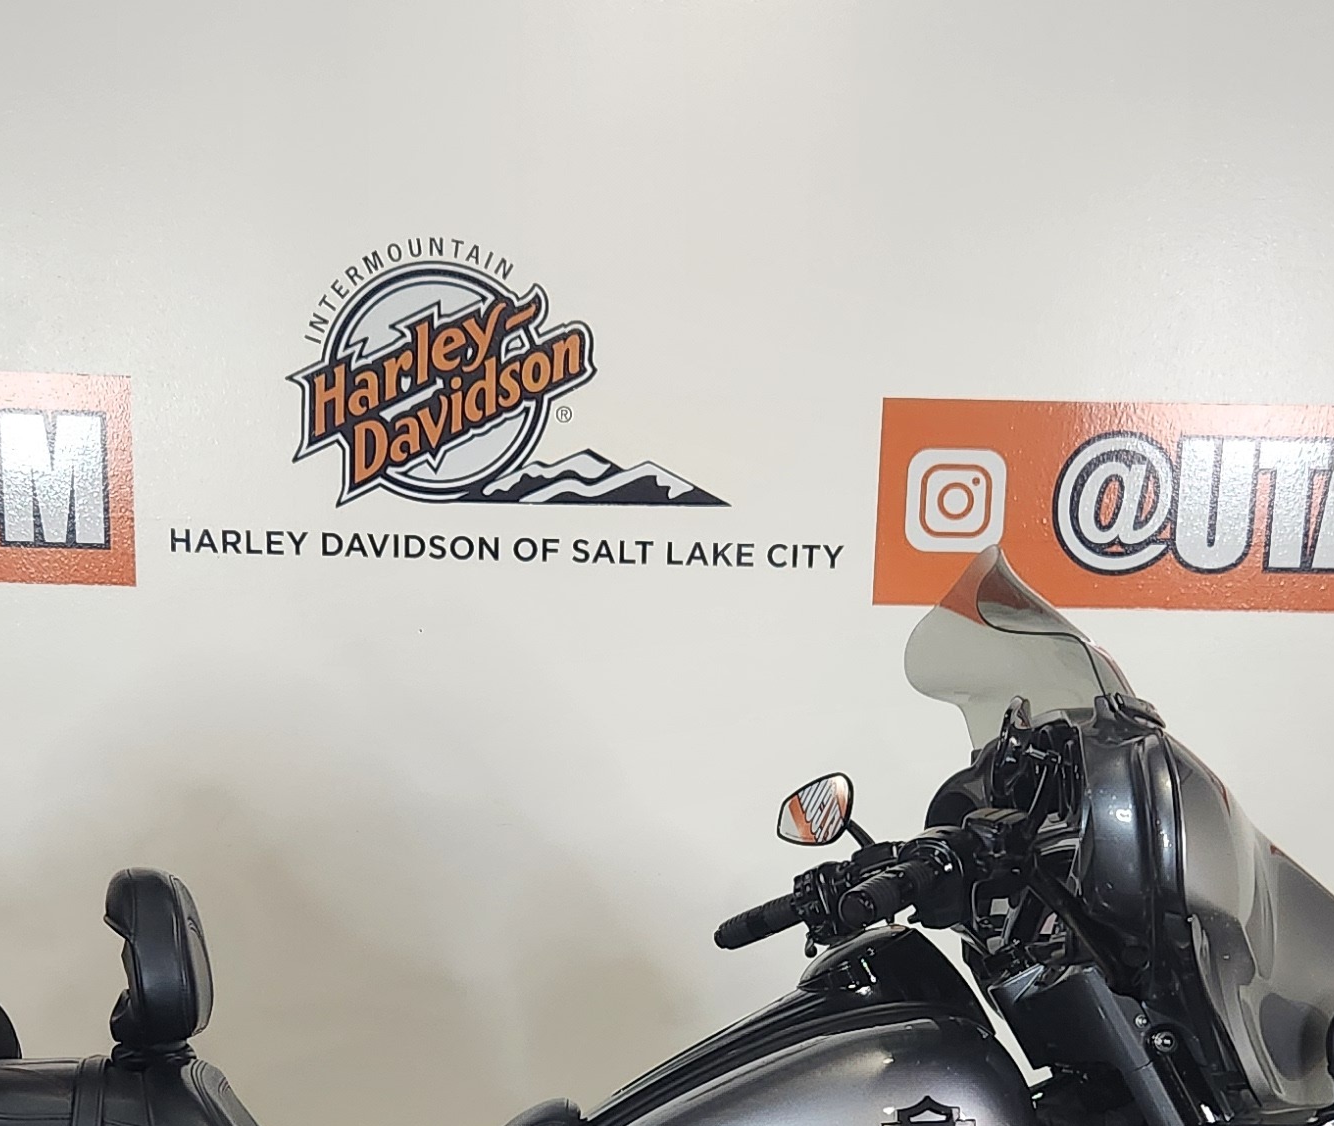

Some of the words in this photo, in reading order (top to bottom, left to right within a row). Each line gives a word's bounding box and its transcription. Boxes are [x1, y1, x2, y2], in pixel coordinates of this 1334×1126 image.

[304, 236, 514, 345] INTERMOUNTAIN
[354, 333, 581, 484] Davidson
[170, 527, 309, 557] HARLEY
[320, 531, 500, 562] DAVIDSON
[512, 536, 561, 563] OF
[570, 538, 655, 566] SALT
[665, 540, 756, 568] LAKE
[766, 543, 845, 570] CITY
